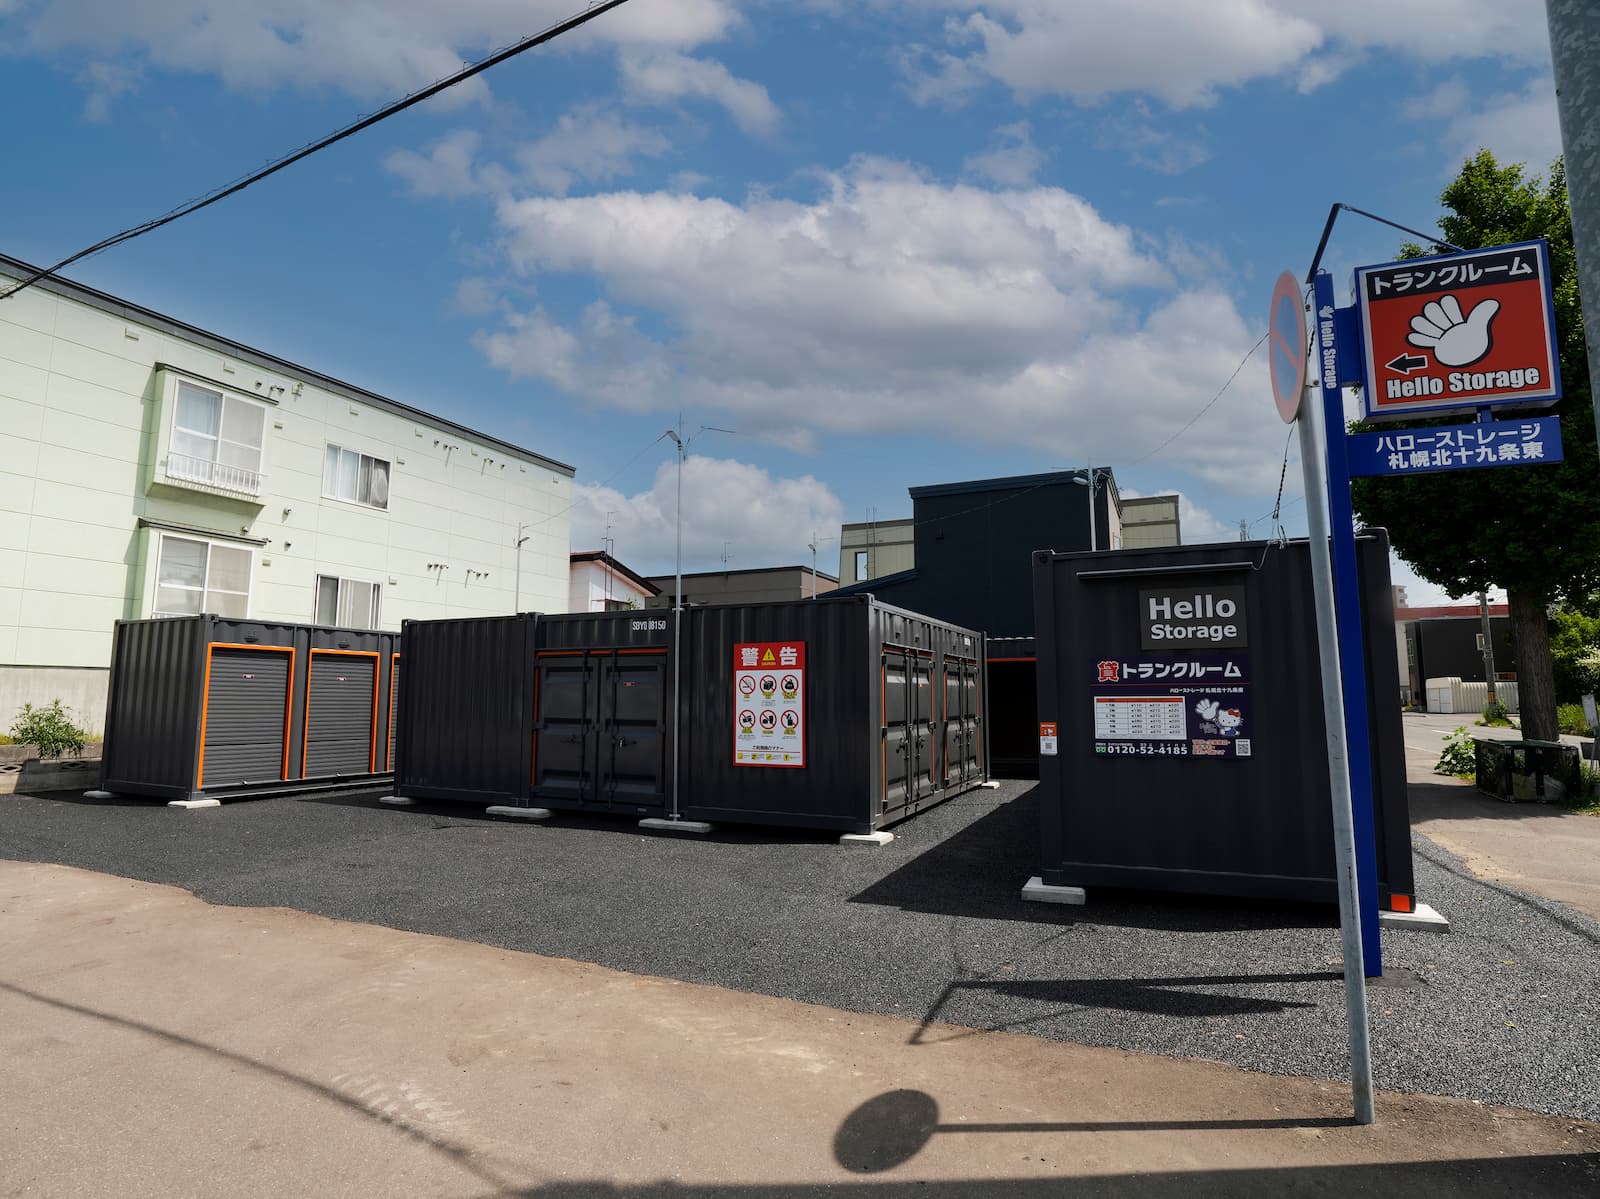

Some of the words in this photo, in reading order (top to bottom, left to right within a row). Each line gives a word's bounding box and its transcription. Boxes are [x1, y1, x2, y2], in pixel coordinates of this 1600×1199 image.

[1374, 256, 1533, 296] トランクルーム
[1320, 321, 1334, 347] Hello
[1323, 348, 1337, 389] Storage
[1386, 378, 1444, 399] Hello
[1448, 367, 1540, 393] Storage
[1376, 422, 1541, 453] ハローストレージ
[1388, 440, 1545, 470] 札幌北十九条東
[1148, 594, 1237, 621] Hello
[1150, 623, 1238, 642] Storage
[1107, 745, 1188, 756] 0120-52-4185
